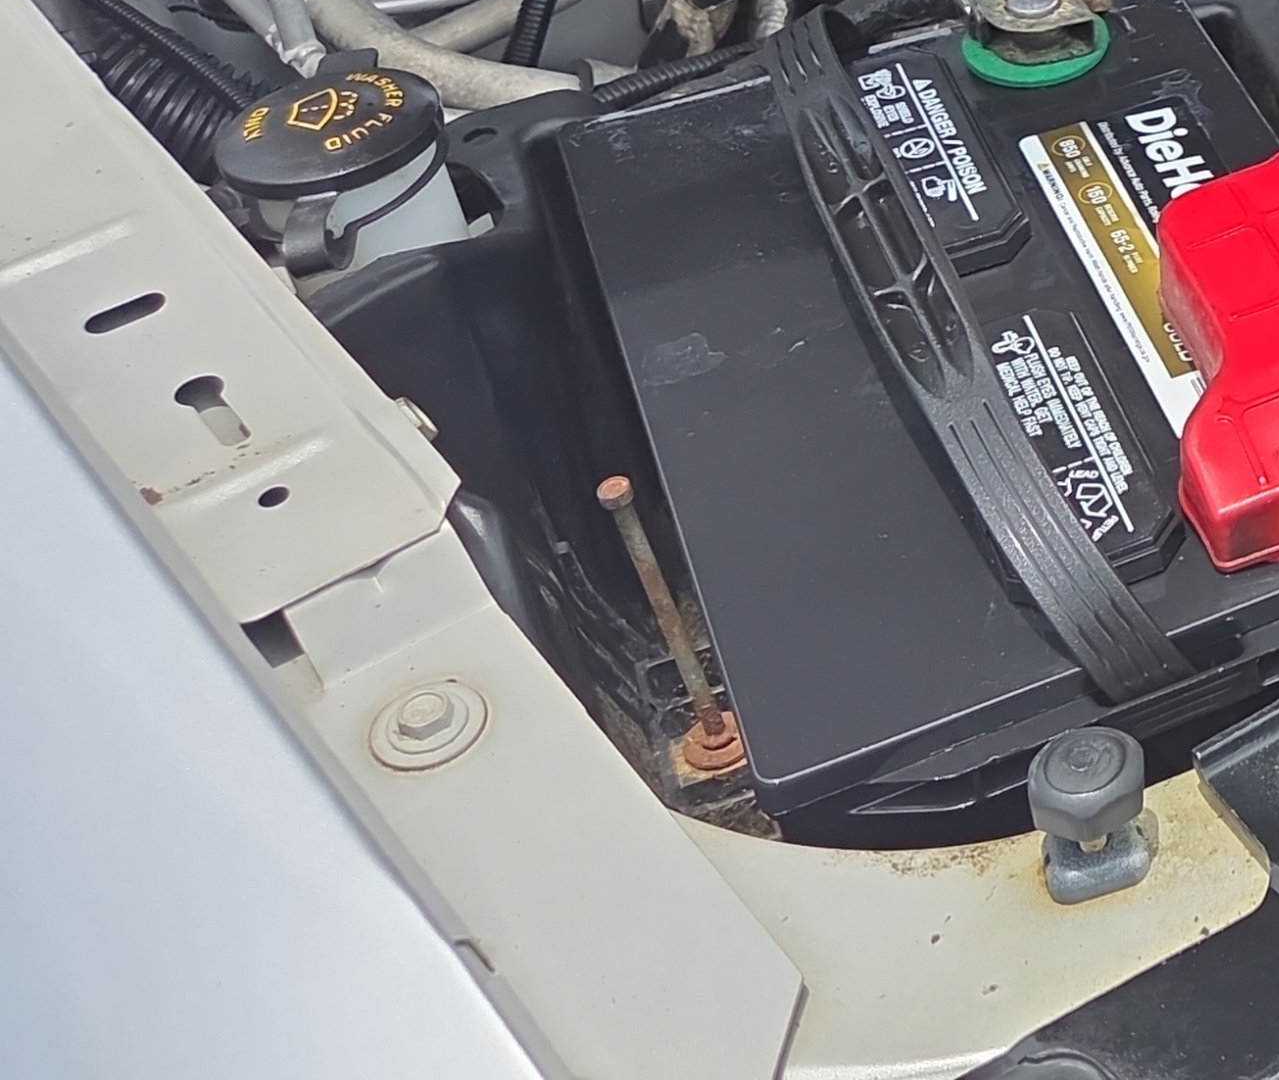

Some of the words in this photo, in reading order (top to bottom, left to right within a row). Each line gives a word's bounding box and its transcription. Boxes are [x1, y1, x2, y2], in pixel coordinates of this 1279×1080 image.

[346, 73, 404, 107] WASHER
[243, 107, 270, 142] ONLY
[324, 112, 393, 151] FLUID
[918, 88, 956, 138] DANGER
[947, 146, 986, 194] POISON
[1058, 139, 1080, 158] 850
[1126, 107, 1212, 197] DieH
[995, 361, 1021, 396] MEDICAL
[1010, 357, 1030, 378] WITH
[1034, 406, 1053, 423] GET
[1011, 394, 1032, 415] HELP
[1024, 352, 1046, 378] FLUSH
[1036, 377, 1056, 398] EYES
[1046, 398, 1081, 448] IMMEDIATELY
[1020, 415, 1042, 436] FAST
[1069, 469, 1097, 478] LEAD
